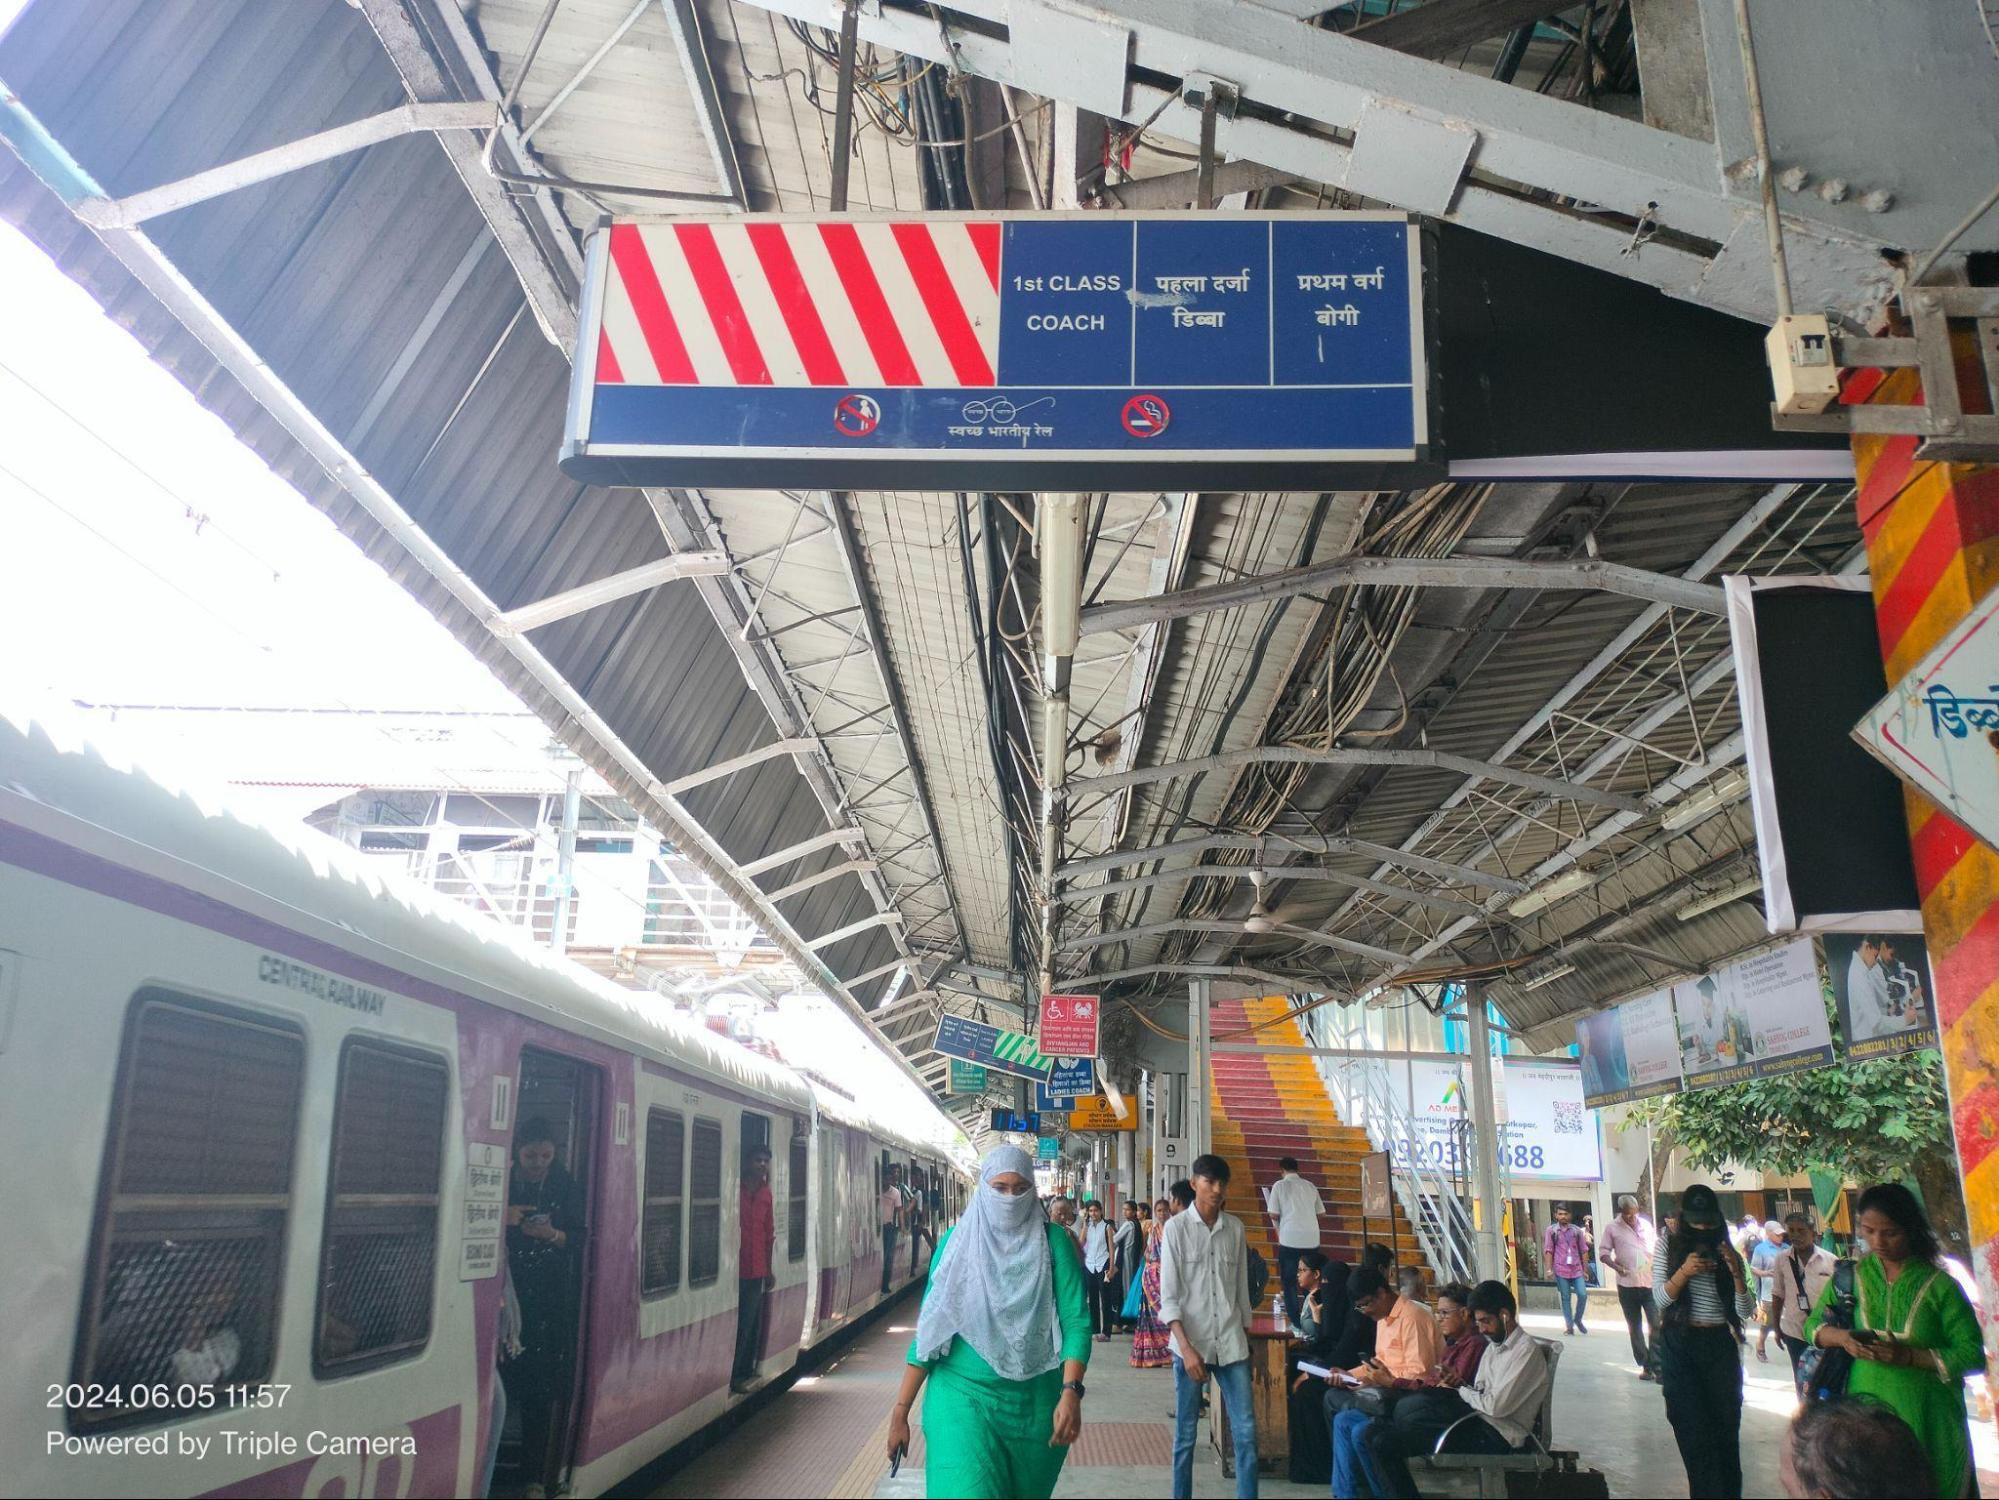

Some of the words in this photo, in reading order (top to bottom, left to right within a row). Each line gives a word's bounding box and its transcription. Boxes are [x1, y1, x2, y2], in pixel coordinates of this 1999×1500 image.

[1013, 276, 1043, 292] 1st
[1049, 275, 1121, 292] CLASS
[1156, 276, 1207, 294] पहला
[1212, 268, 1250, 292] दर्जा
[1297, 273, 1347, 291] प्रथम
[1354, 266, 1385, 290] वर्ग
[1026, 315, 1105, 331] COACH
[1172, 307, 1225, 328] डिब्बा
[1315, 304, 1360, 326] बोगी
[948, 426, 984, 437] स्वच्छ
[988, 423, 1031, 437] भारतीय
[1034, 422, 1054, 437] रेल
[1050, 1088, 1070, 1096] LADIES
[1071, 1087, 1091, 1095] COACH
